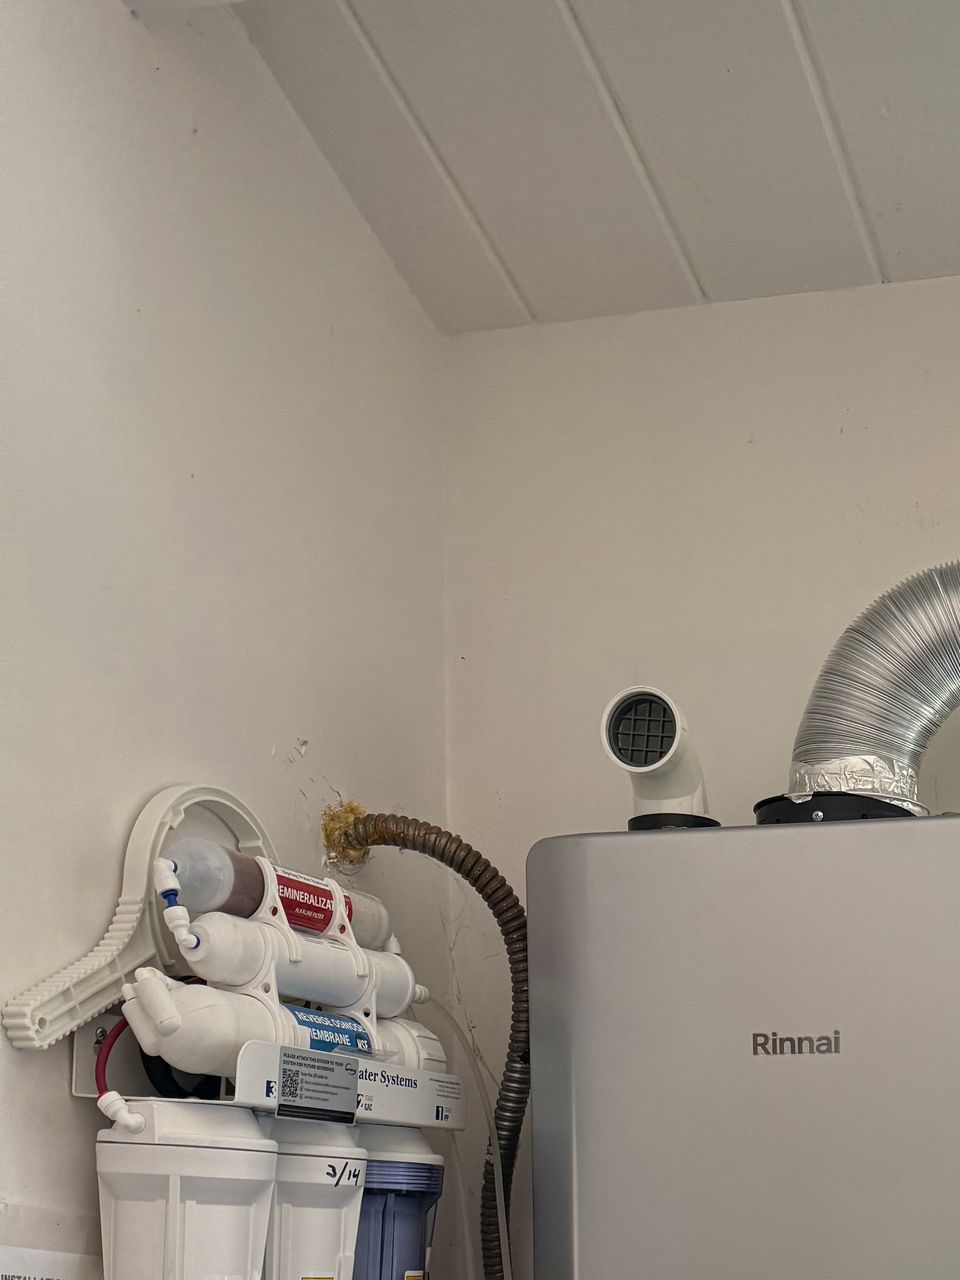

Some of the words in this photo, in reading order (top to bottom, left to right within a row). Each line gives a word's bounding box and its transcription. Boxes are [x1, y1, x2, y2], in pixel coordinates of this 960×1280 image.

[752, 1029, 840, 1055] Rinnai
[358, 1069, 379, 1082] ater
[379, 1070, 418, 1089] Systems
[326, 1161, 361, 1187] 3/14
